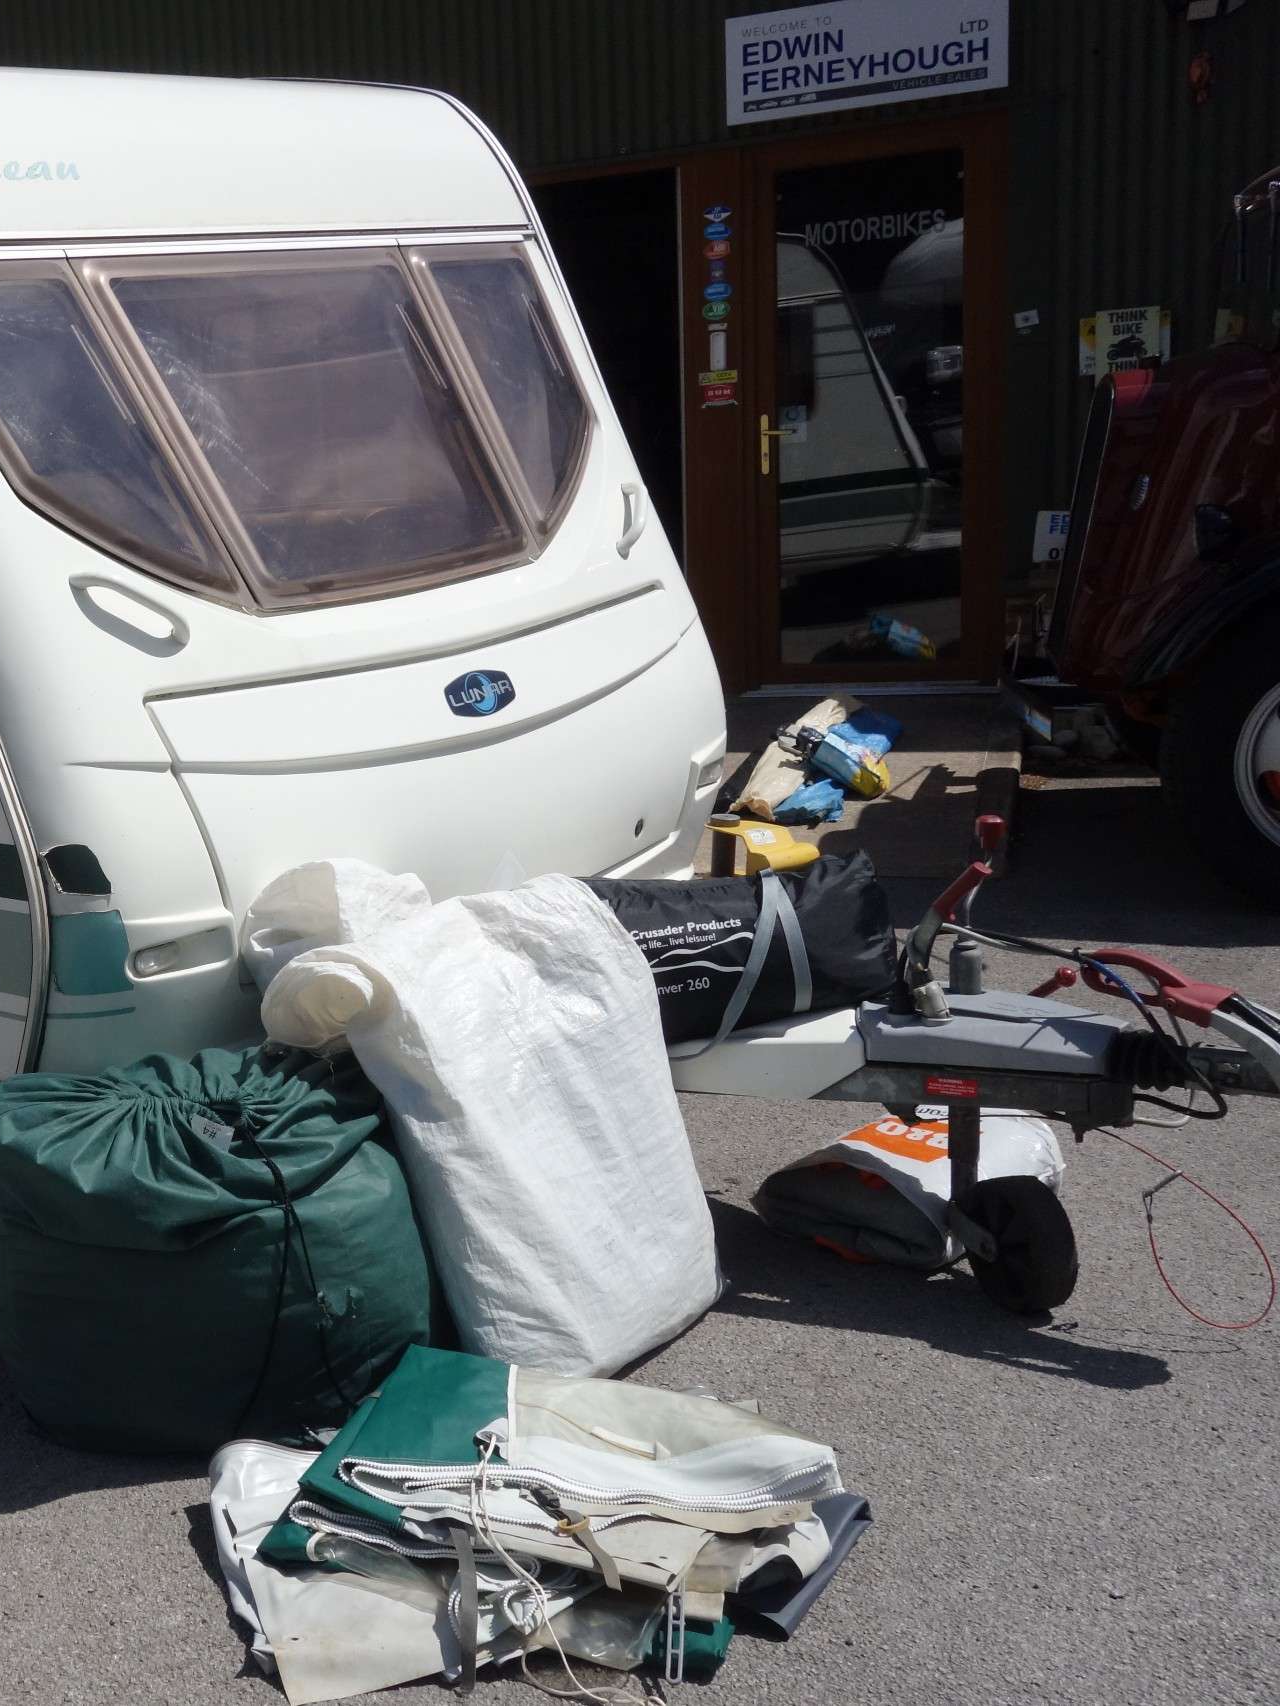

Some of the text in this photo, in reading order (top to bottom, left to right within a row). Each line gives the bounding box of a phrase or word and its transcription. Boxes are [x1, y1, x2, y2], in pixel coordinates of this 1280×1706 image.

[741, 15, 832, 38] WELCOME TO
[960, 19, 989, 34] LTD
[742, 29, 845, 67] EDWIN
[742, 37, 990, 96] FERNEYHOUGH
[805, 208, 947, 248] MOTORBIKES
[1108, 310, 1148, 323] THINK
[1113, 322, 1143, 335] BIKE
[1107, 359, 1138, 370] THIN
[448, 679, 512, 707] LUNAR
[629, 917, 742, 941] Crusader Products
[669, 937, 685, 946] live
[685, 932, 716, 944] leisure!
[685, 976, 711, 991] 260
